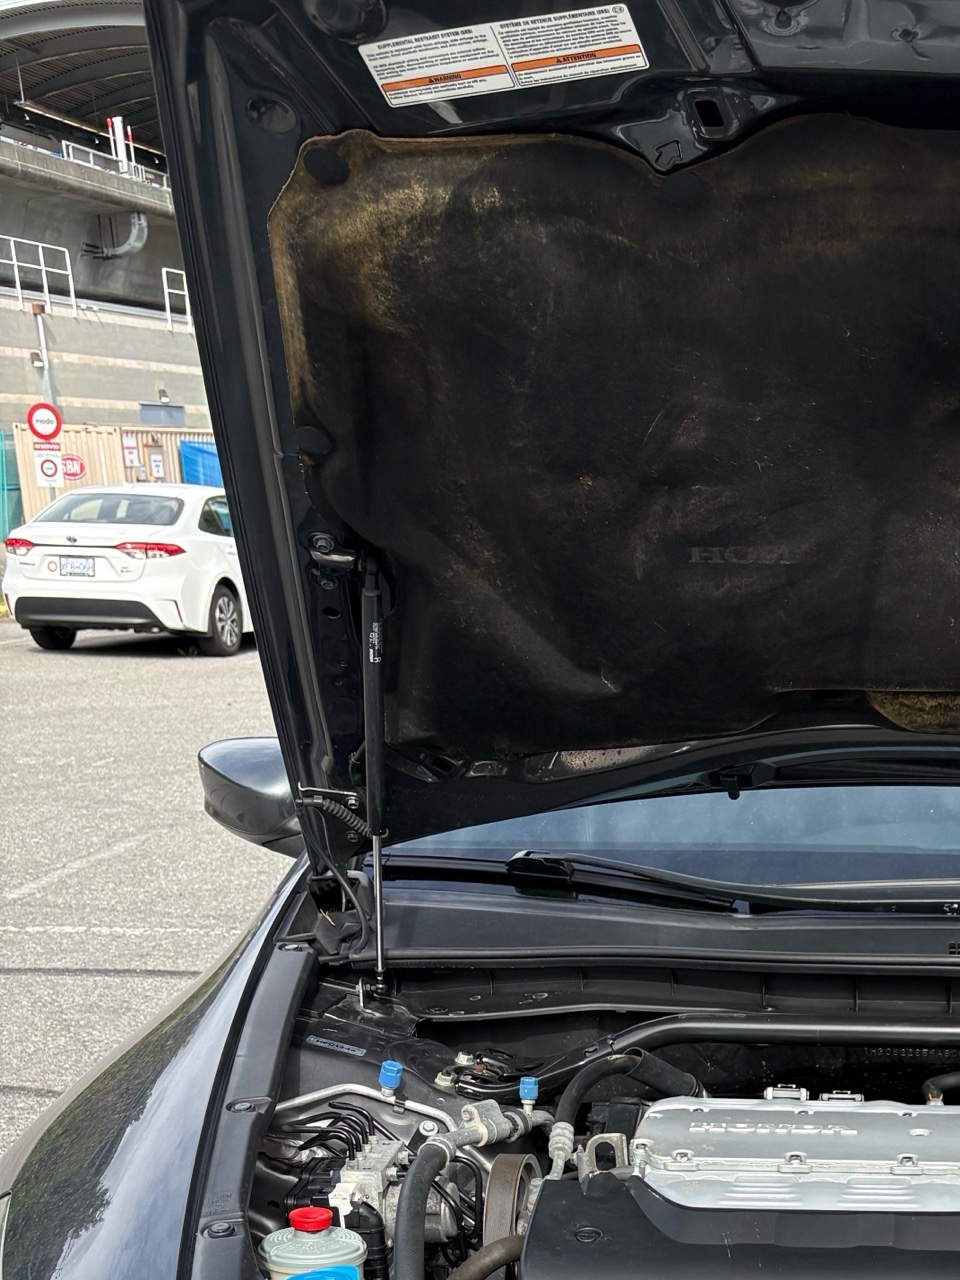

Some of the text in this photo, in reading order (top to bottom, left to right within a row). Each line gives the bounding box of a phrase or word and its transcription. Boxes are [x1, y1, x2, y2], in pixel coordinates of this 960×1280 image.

[562, 52, 596, 62] ATTENTION
[433, 73, 461, 82] WARNING
[689, 1122, 858, 1135] HONDA
